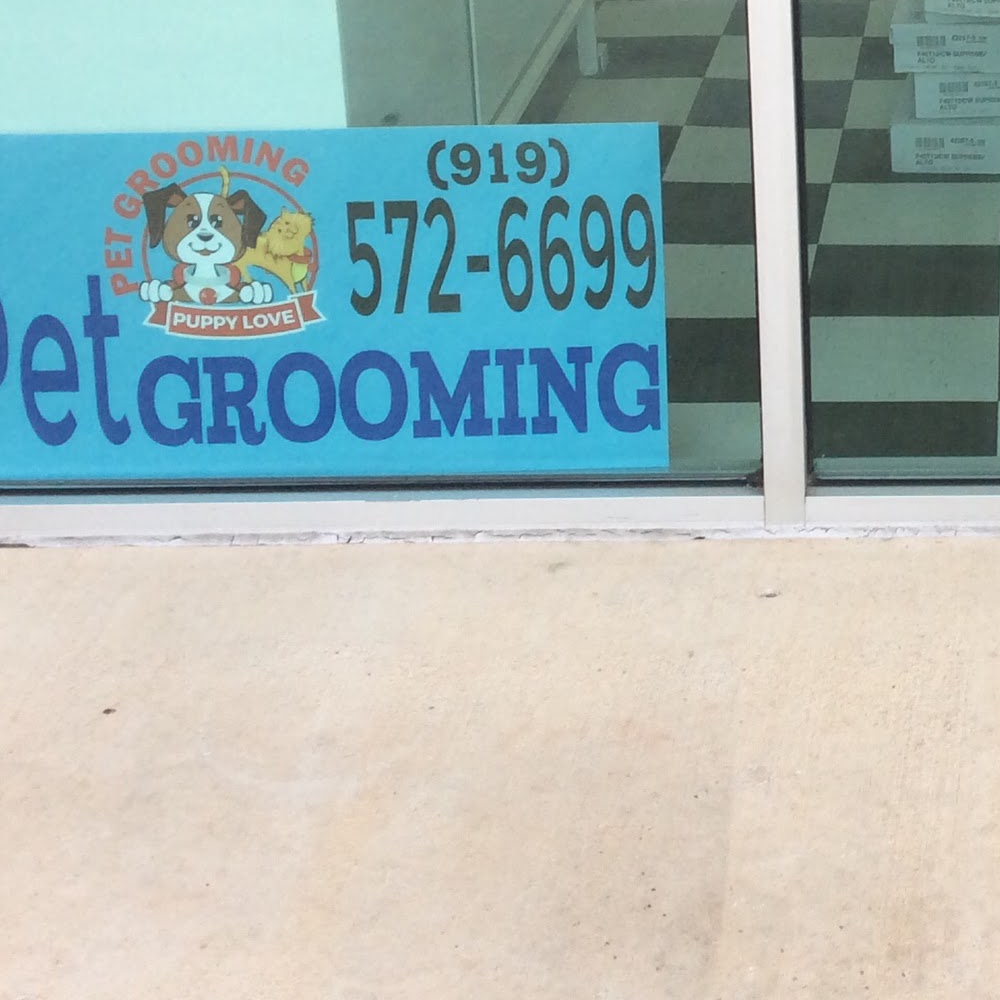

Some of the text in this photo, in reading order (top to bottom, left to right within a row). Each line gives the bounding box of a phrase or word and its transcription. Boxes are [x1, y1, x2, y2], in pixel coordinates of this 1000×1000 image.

[104, 135, 310, 296] PET GROOMING
[427, 138, 570, 190] (919)
[346, 193, 656, 316] 572-6699
[0, 275, 661, 447] et GROOMING
[172, 308, 296, 330] PUPPY LOVE
